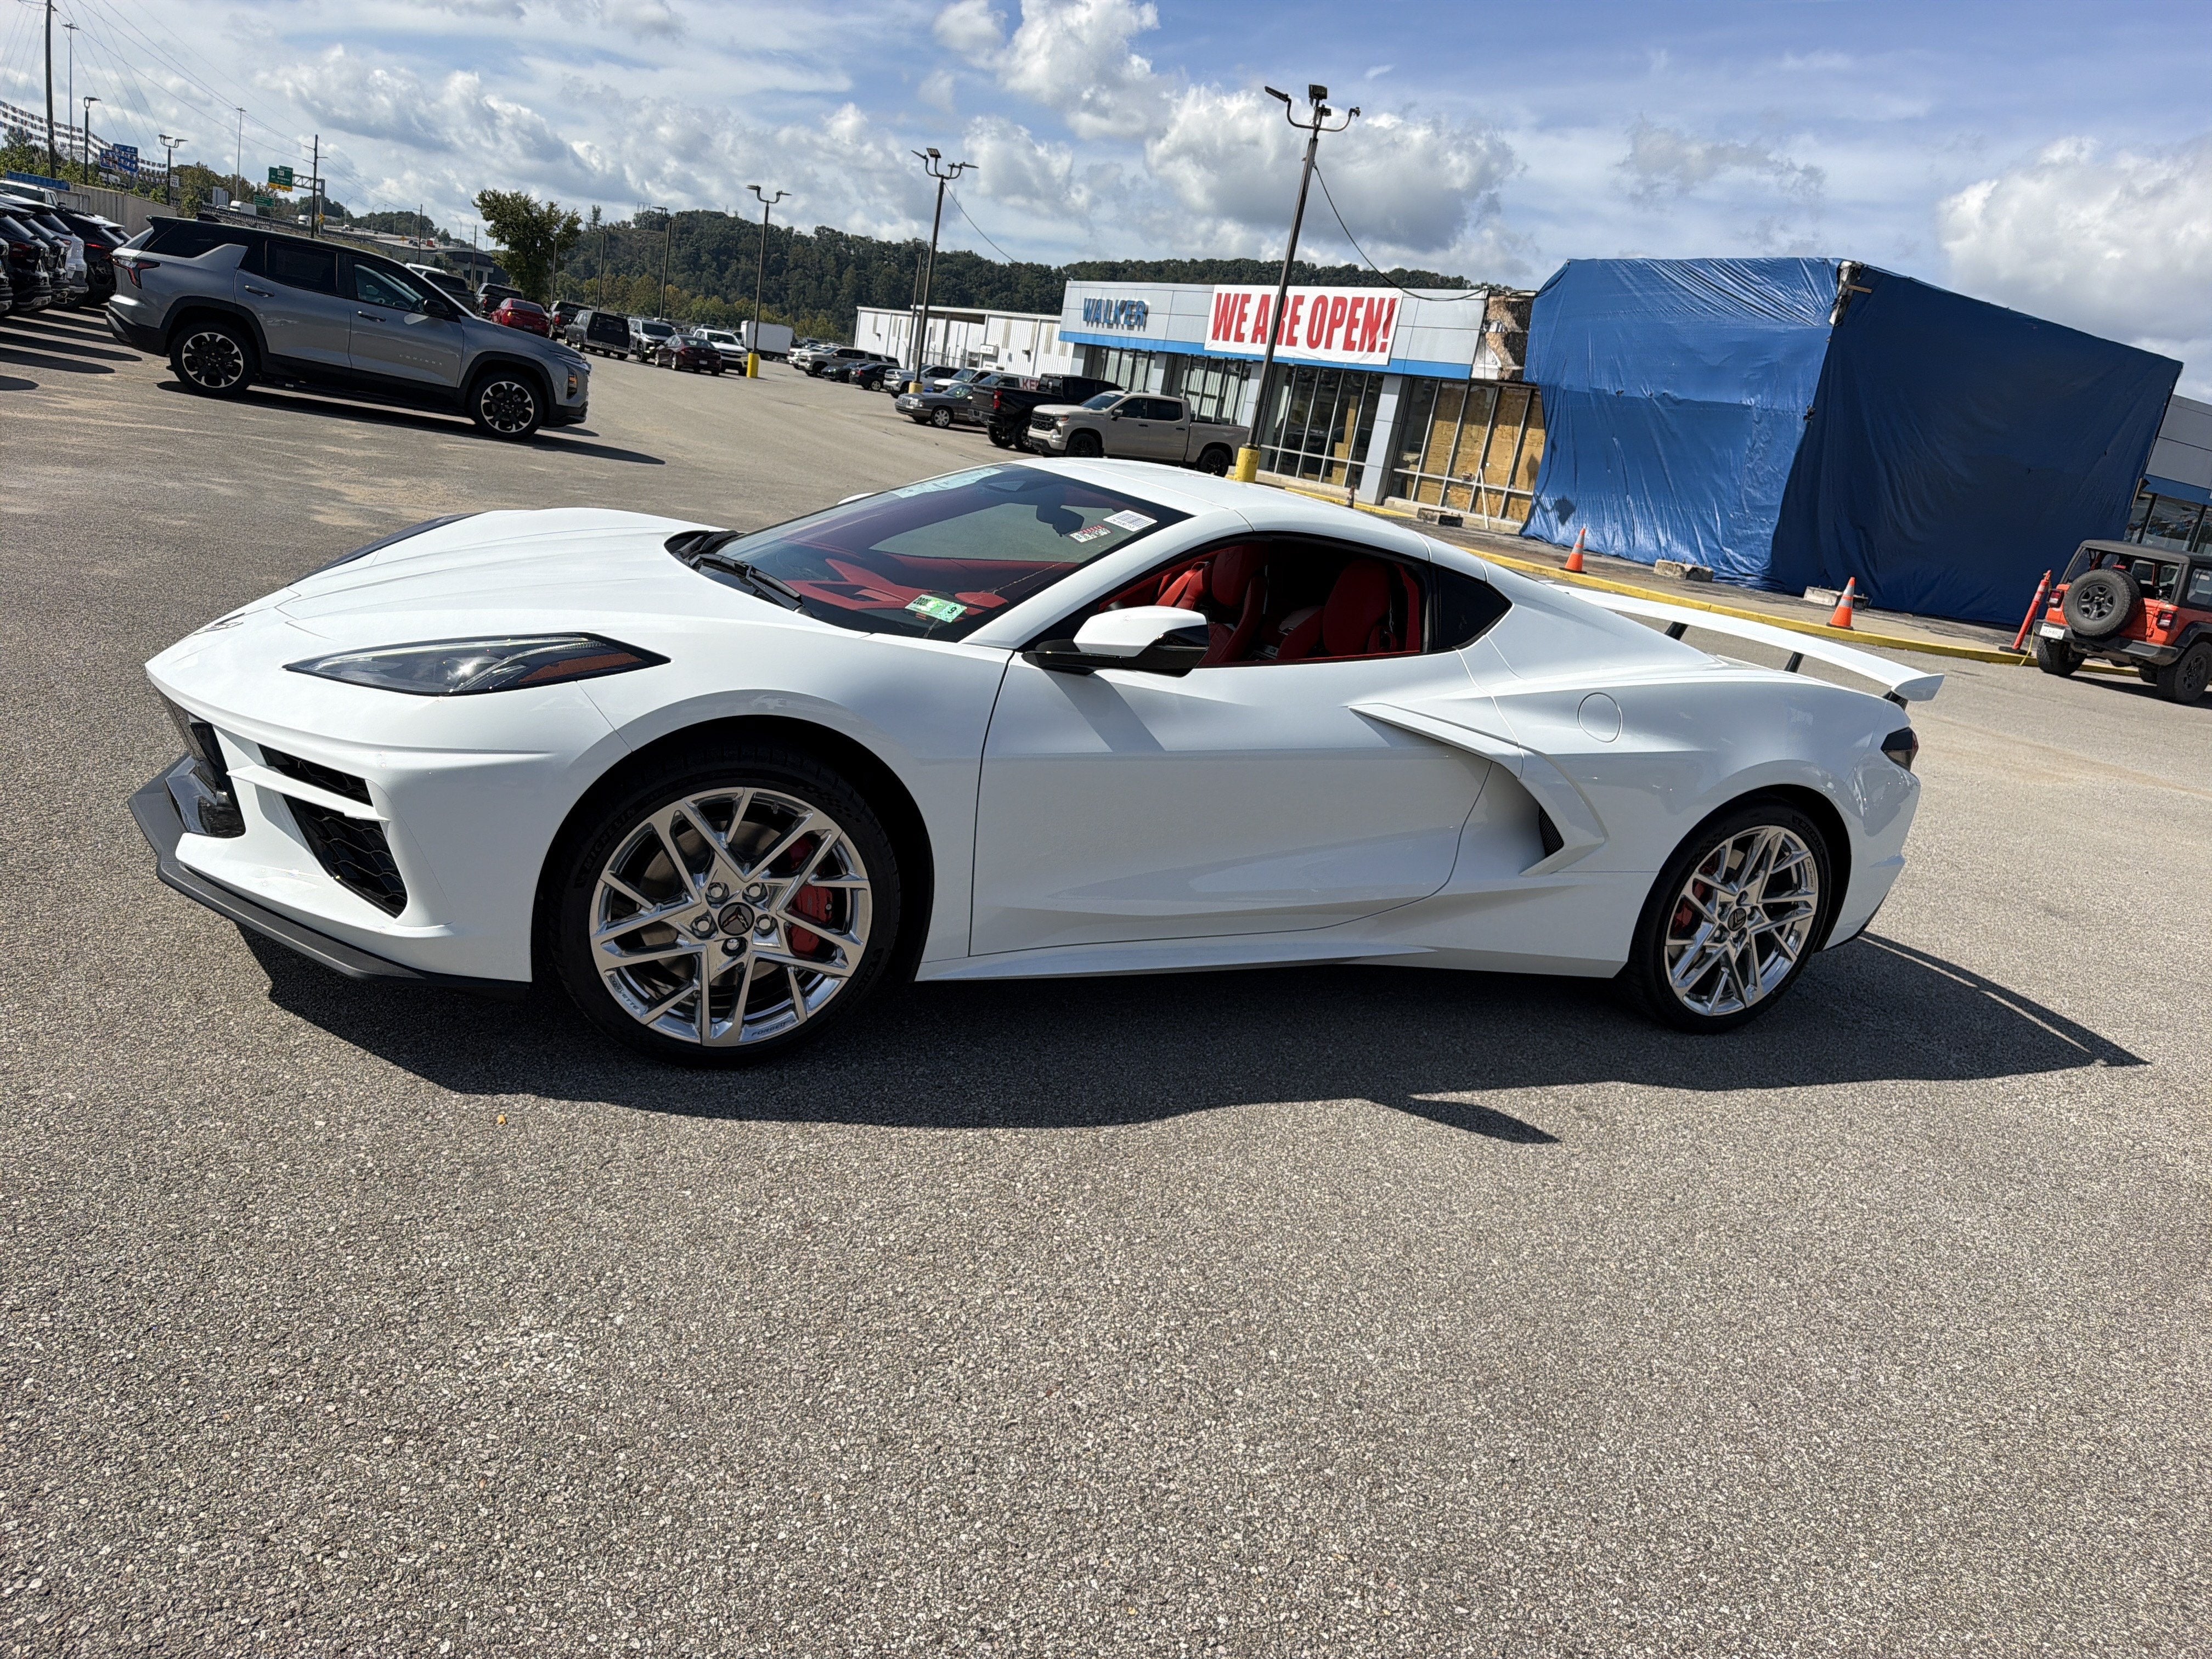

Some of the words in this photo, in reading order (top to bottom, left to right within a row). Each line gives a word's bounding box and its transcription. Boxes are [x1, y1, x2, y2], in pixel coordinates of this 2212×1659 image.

[1083, 298, 1147, 326] WALKER
[1212, 293, 1251, 342] WE
[1250, 294, 1305, 347] ARE
[1307, 295, 1398, 353] OPEN!
